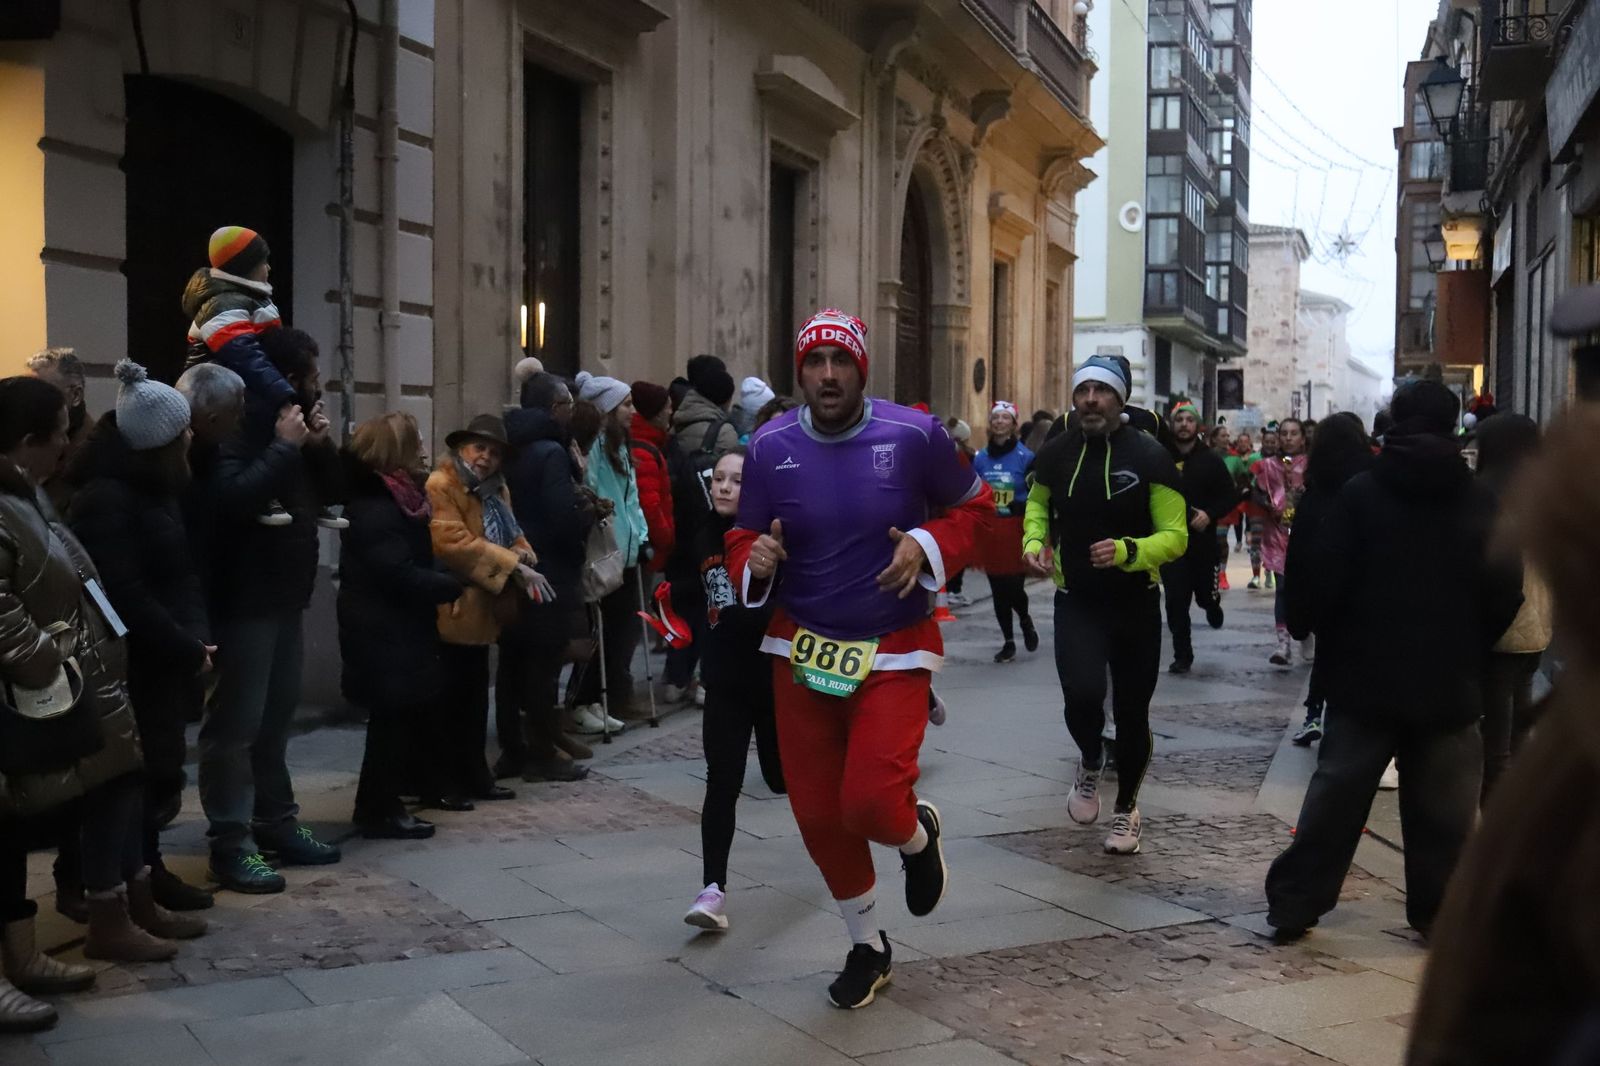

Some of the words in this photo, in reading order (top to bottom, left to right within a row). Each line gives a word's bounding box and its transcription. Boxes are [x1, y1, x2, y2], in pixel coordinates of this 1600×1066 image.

[799, 330, 817, 352] OH
[775, 463, 800, 471] MERCURY
[794, 633, 863, 677] 986
